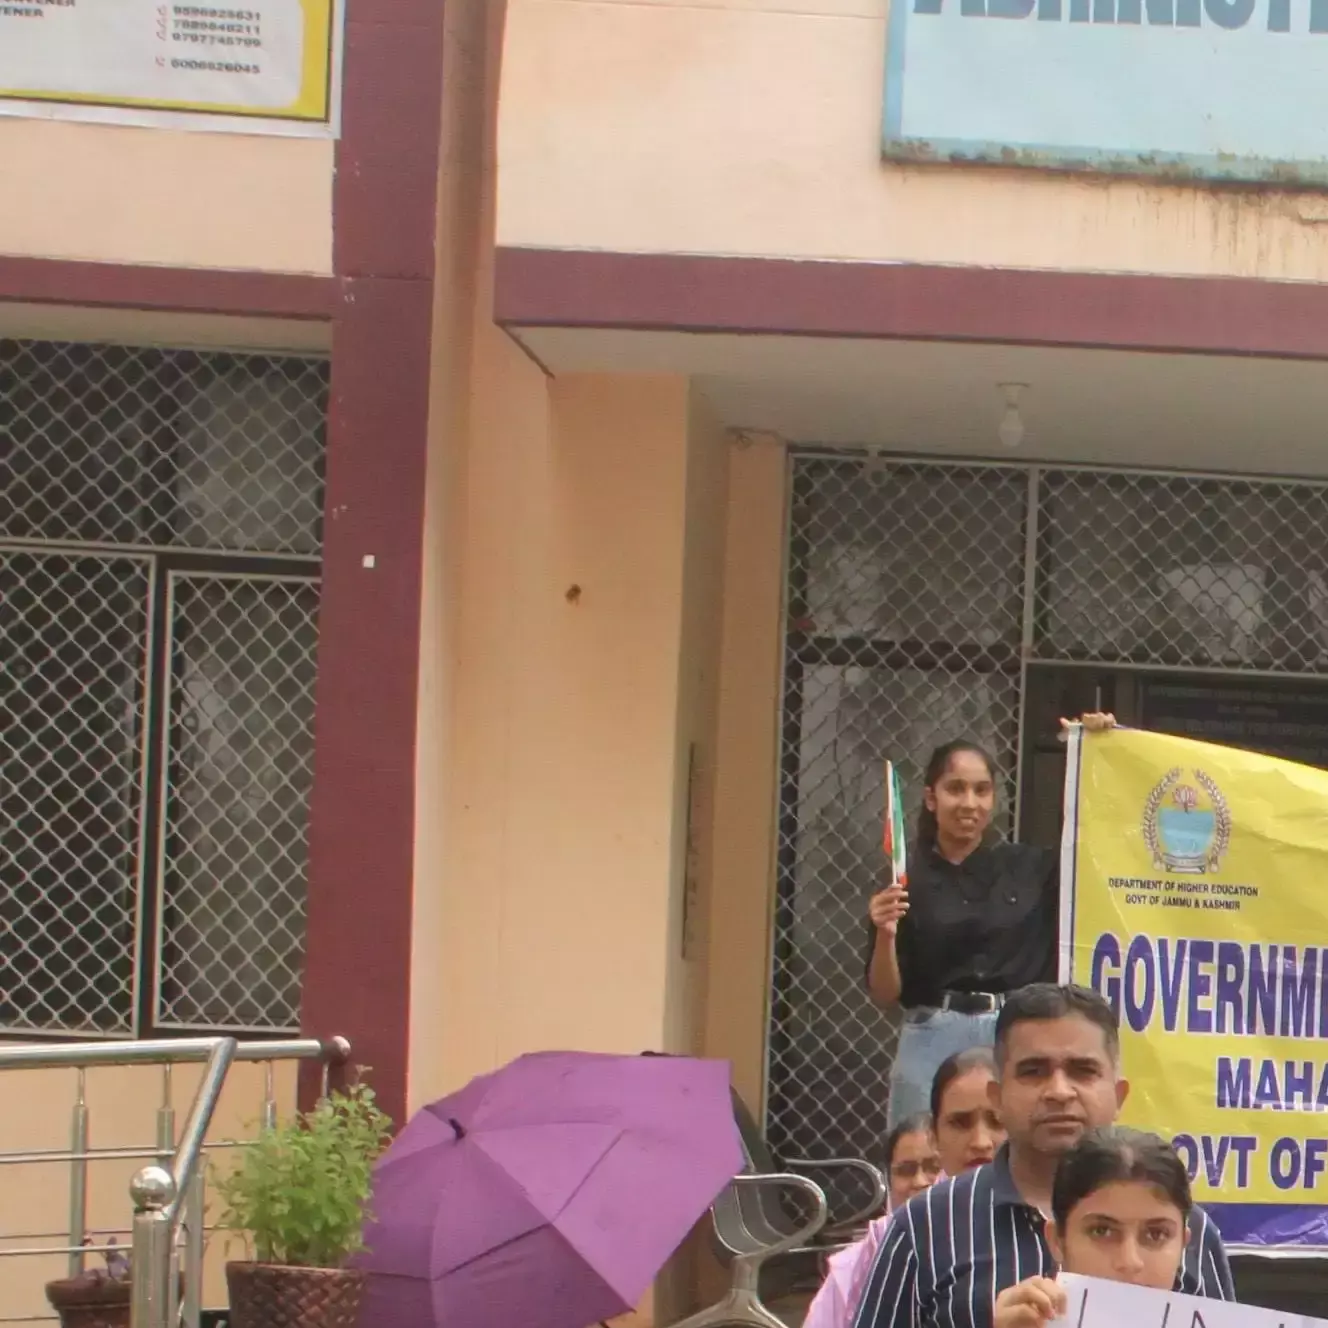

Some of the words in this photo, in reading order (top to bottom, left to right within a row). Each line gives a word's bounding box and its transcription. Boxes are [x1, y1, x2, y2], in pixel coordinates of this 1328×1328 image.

[1108, 877, 1162, 891] DEPARTMENT
[1164, 882, 1175, 891] OF
[1177, 883, 1209, 894] HIGHER
[1211, 884, 1259, 897] EDUCATION
[1125, 894, 1147, 905] GOVT
[1149, 895, 1160, 905] OF
[1161, 897, 1192, 908] JAMMU
[1194, 899, 1200, 909] &
[1202, 899, 1241, 911] KASHMIR
[1171, 1134, 1257, 1188] OVT
[1269, 1137, 1328, 1190] OF
